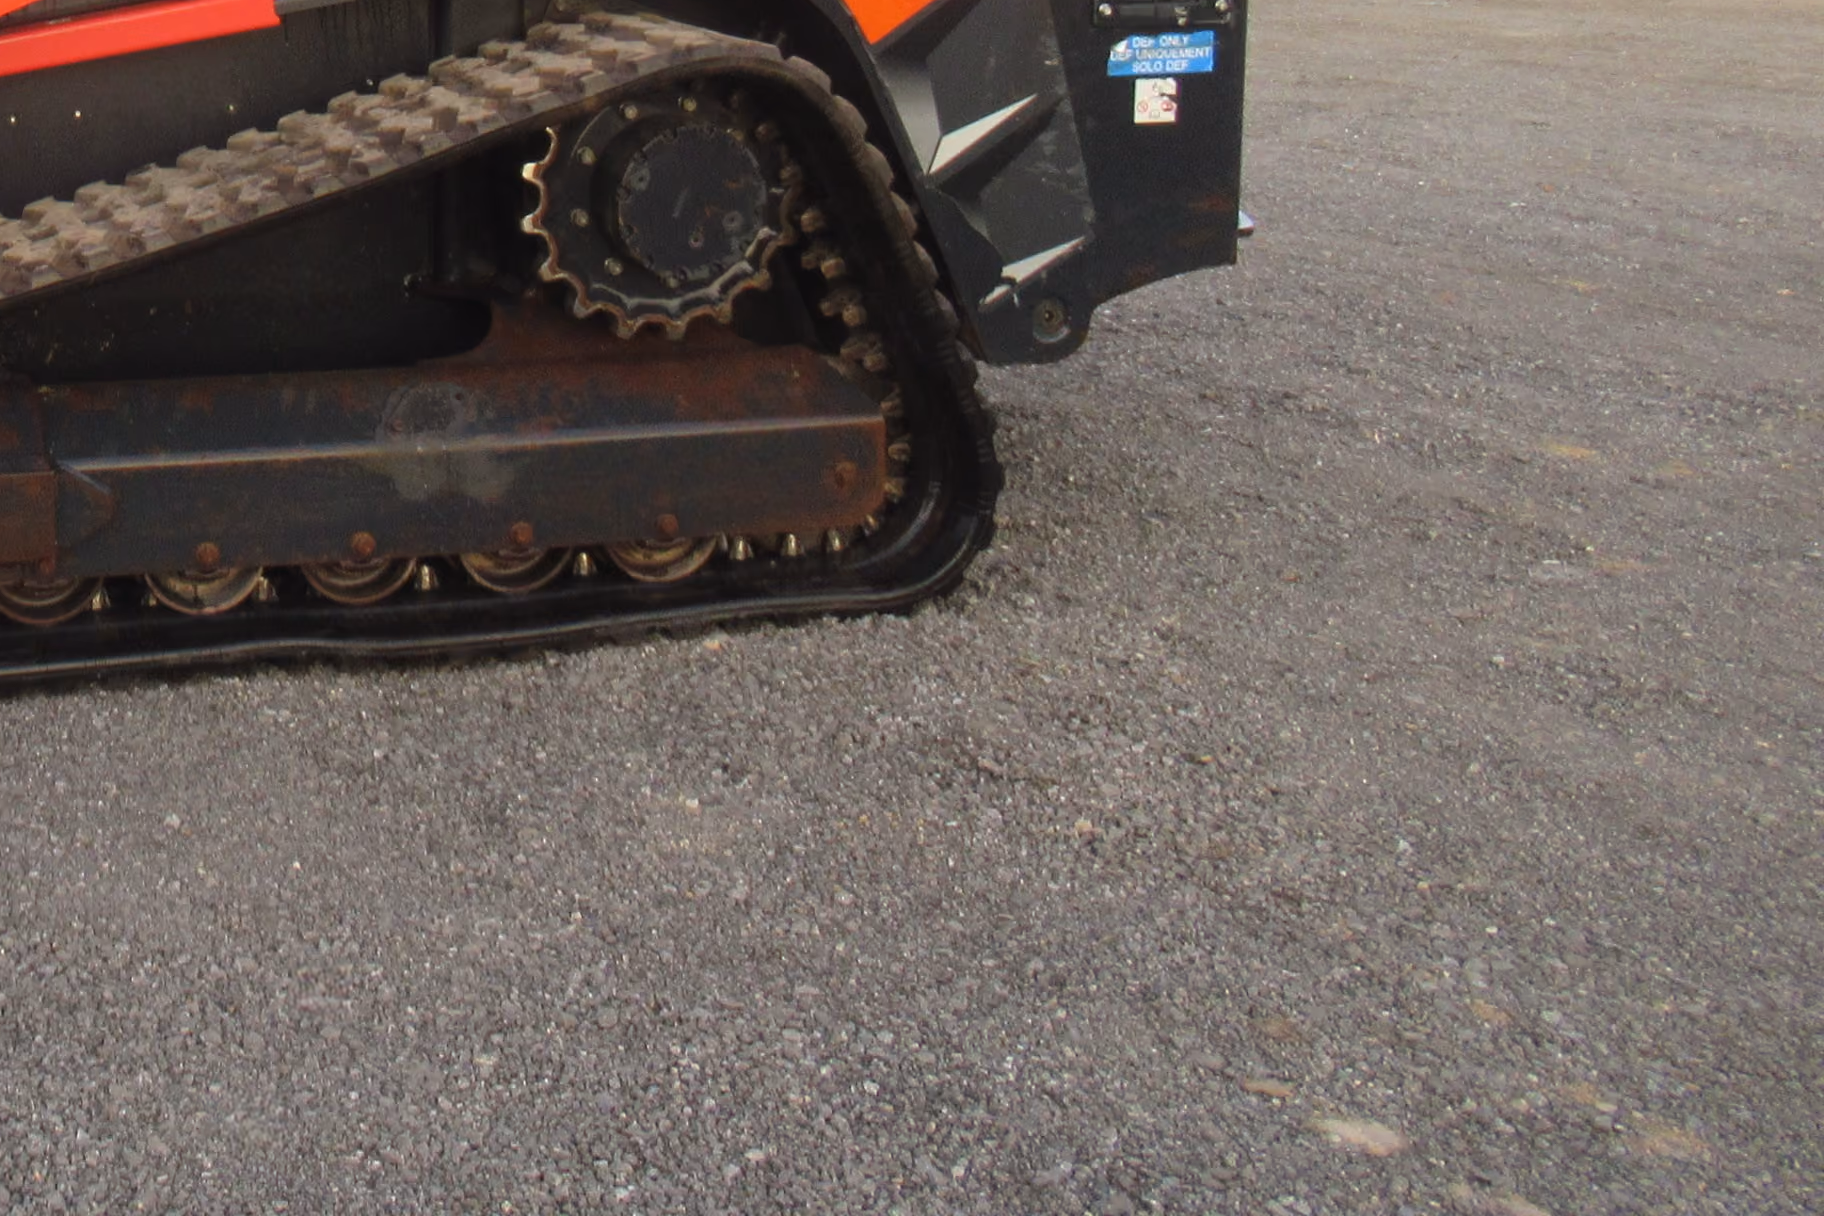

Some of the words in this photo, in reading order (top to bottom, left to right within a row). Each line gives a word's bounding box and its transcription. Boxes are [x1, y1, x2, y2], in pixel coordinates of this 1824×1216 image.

[1132, 36, 1155, 49] DEF
[1159, 34, 1191, 47] ONLY
[1136, 47, 1210, 60] UNIQUEMENT
[1132, 61, 1163, 73] SOLO
[1166, 59, 1189, 72] DEF
